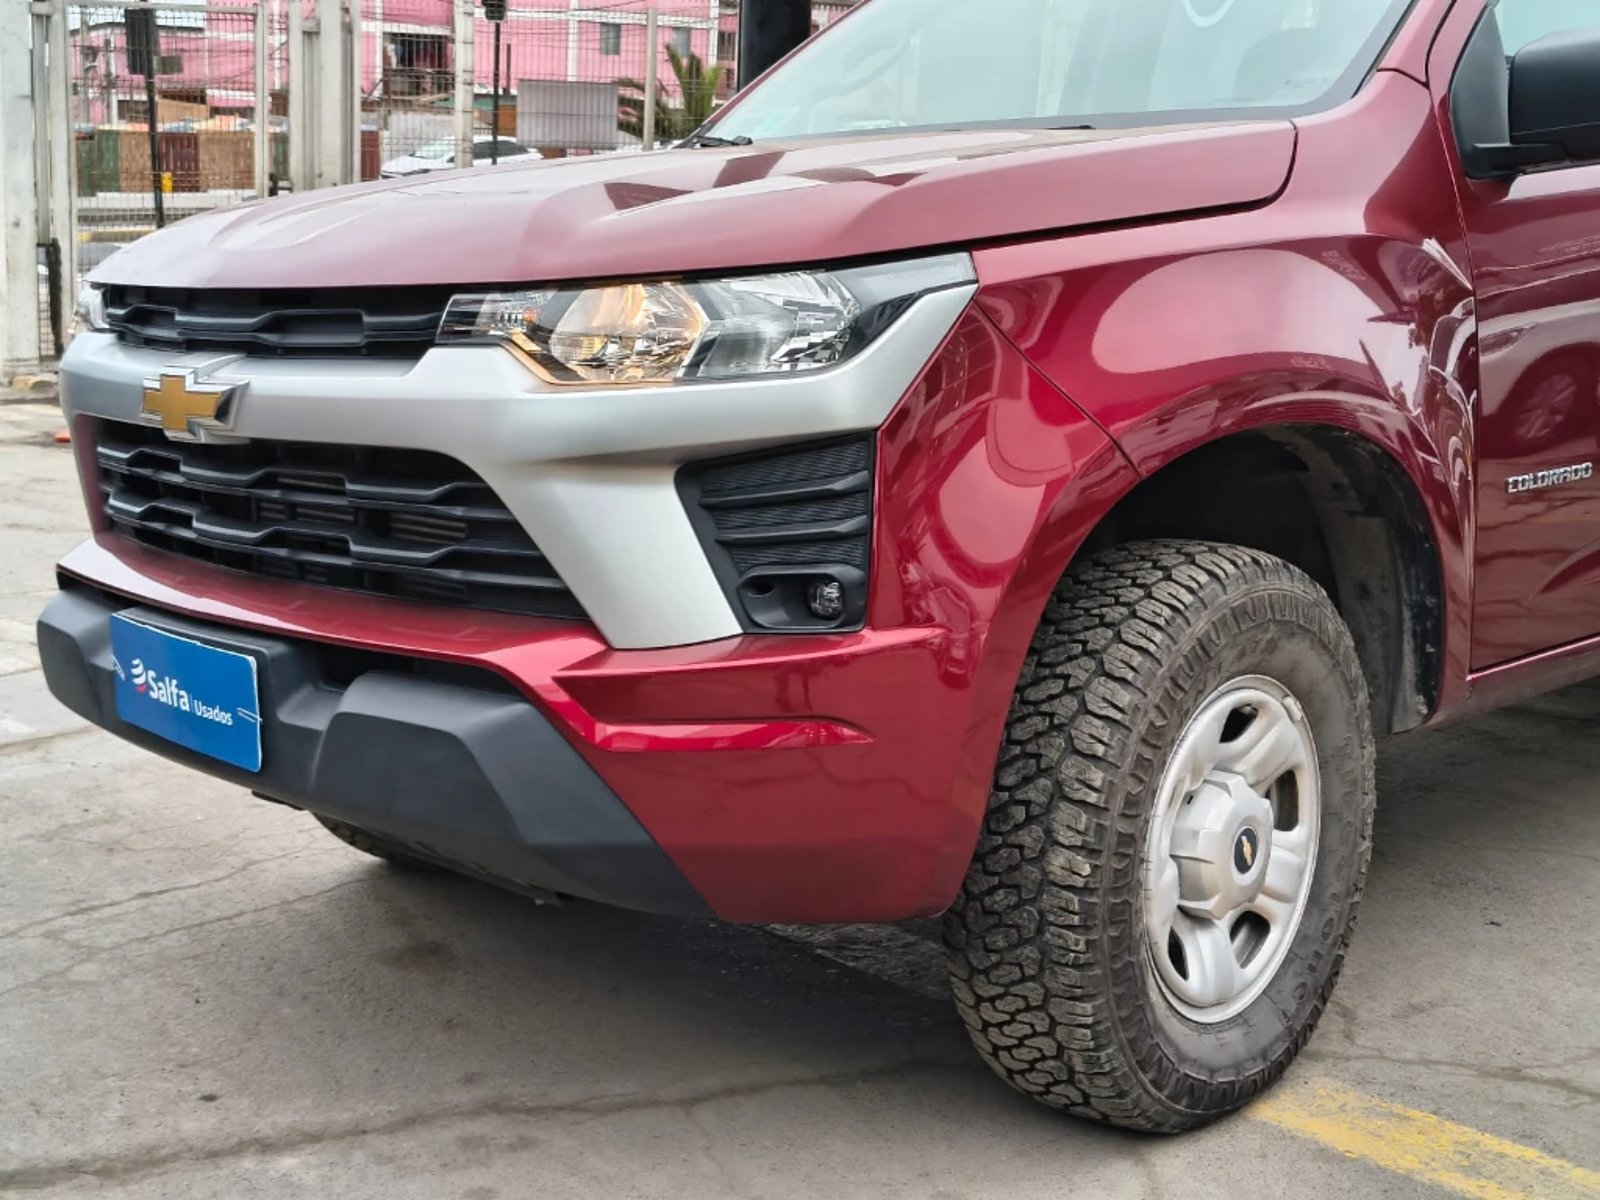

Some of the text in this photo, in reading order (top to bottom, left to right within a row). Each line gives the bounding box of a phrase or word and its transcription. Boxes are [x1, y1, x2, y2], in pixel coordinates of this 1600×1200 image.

[1507, 462, 1593, 493] COLORADO
[147, 670, 234, 726] Salfa Usados
